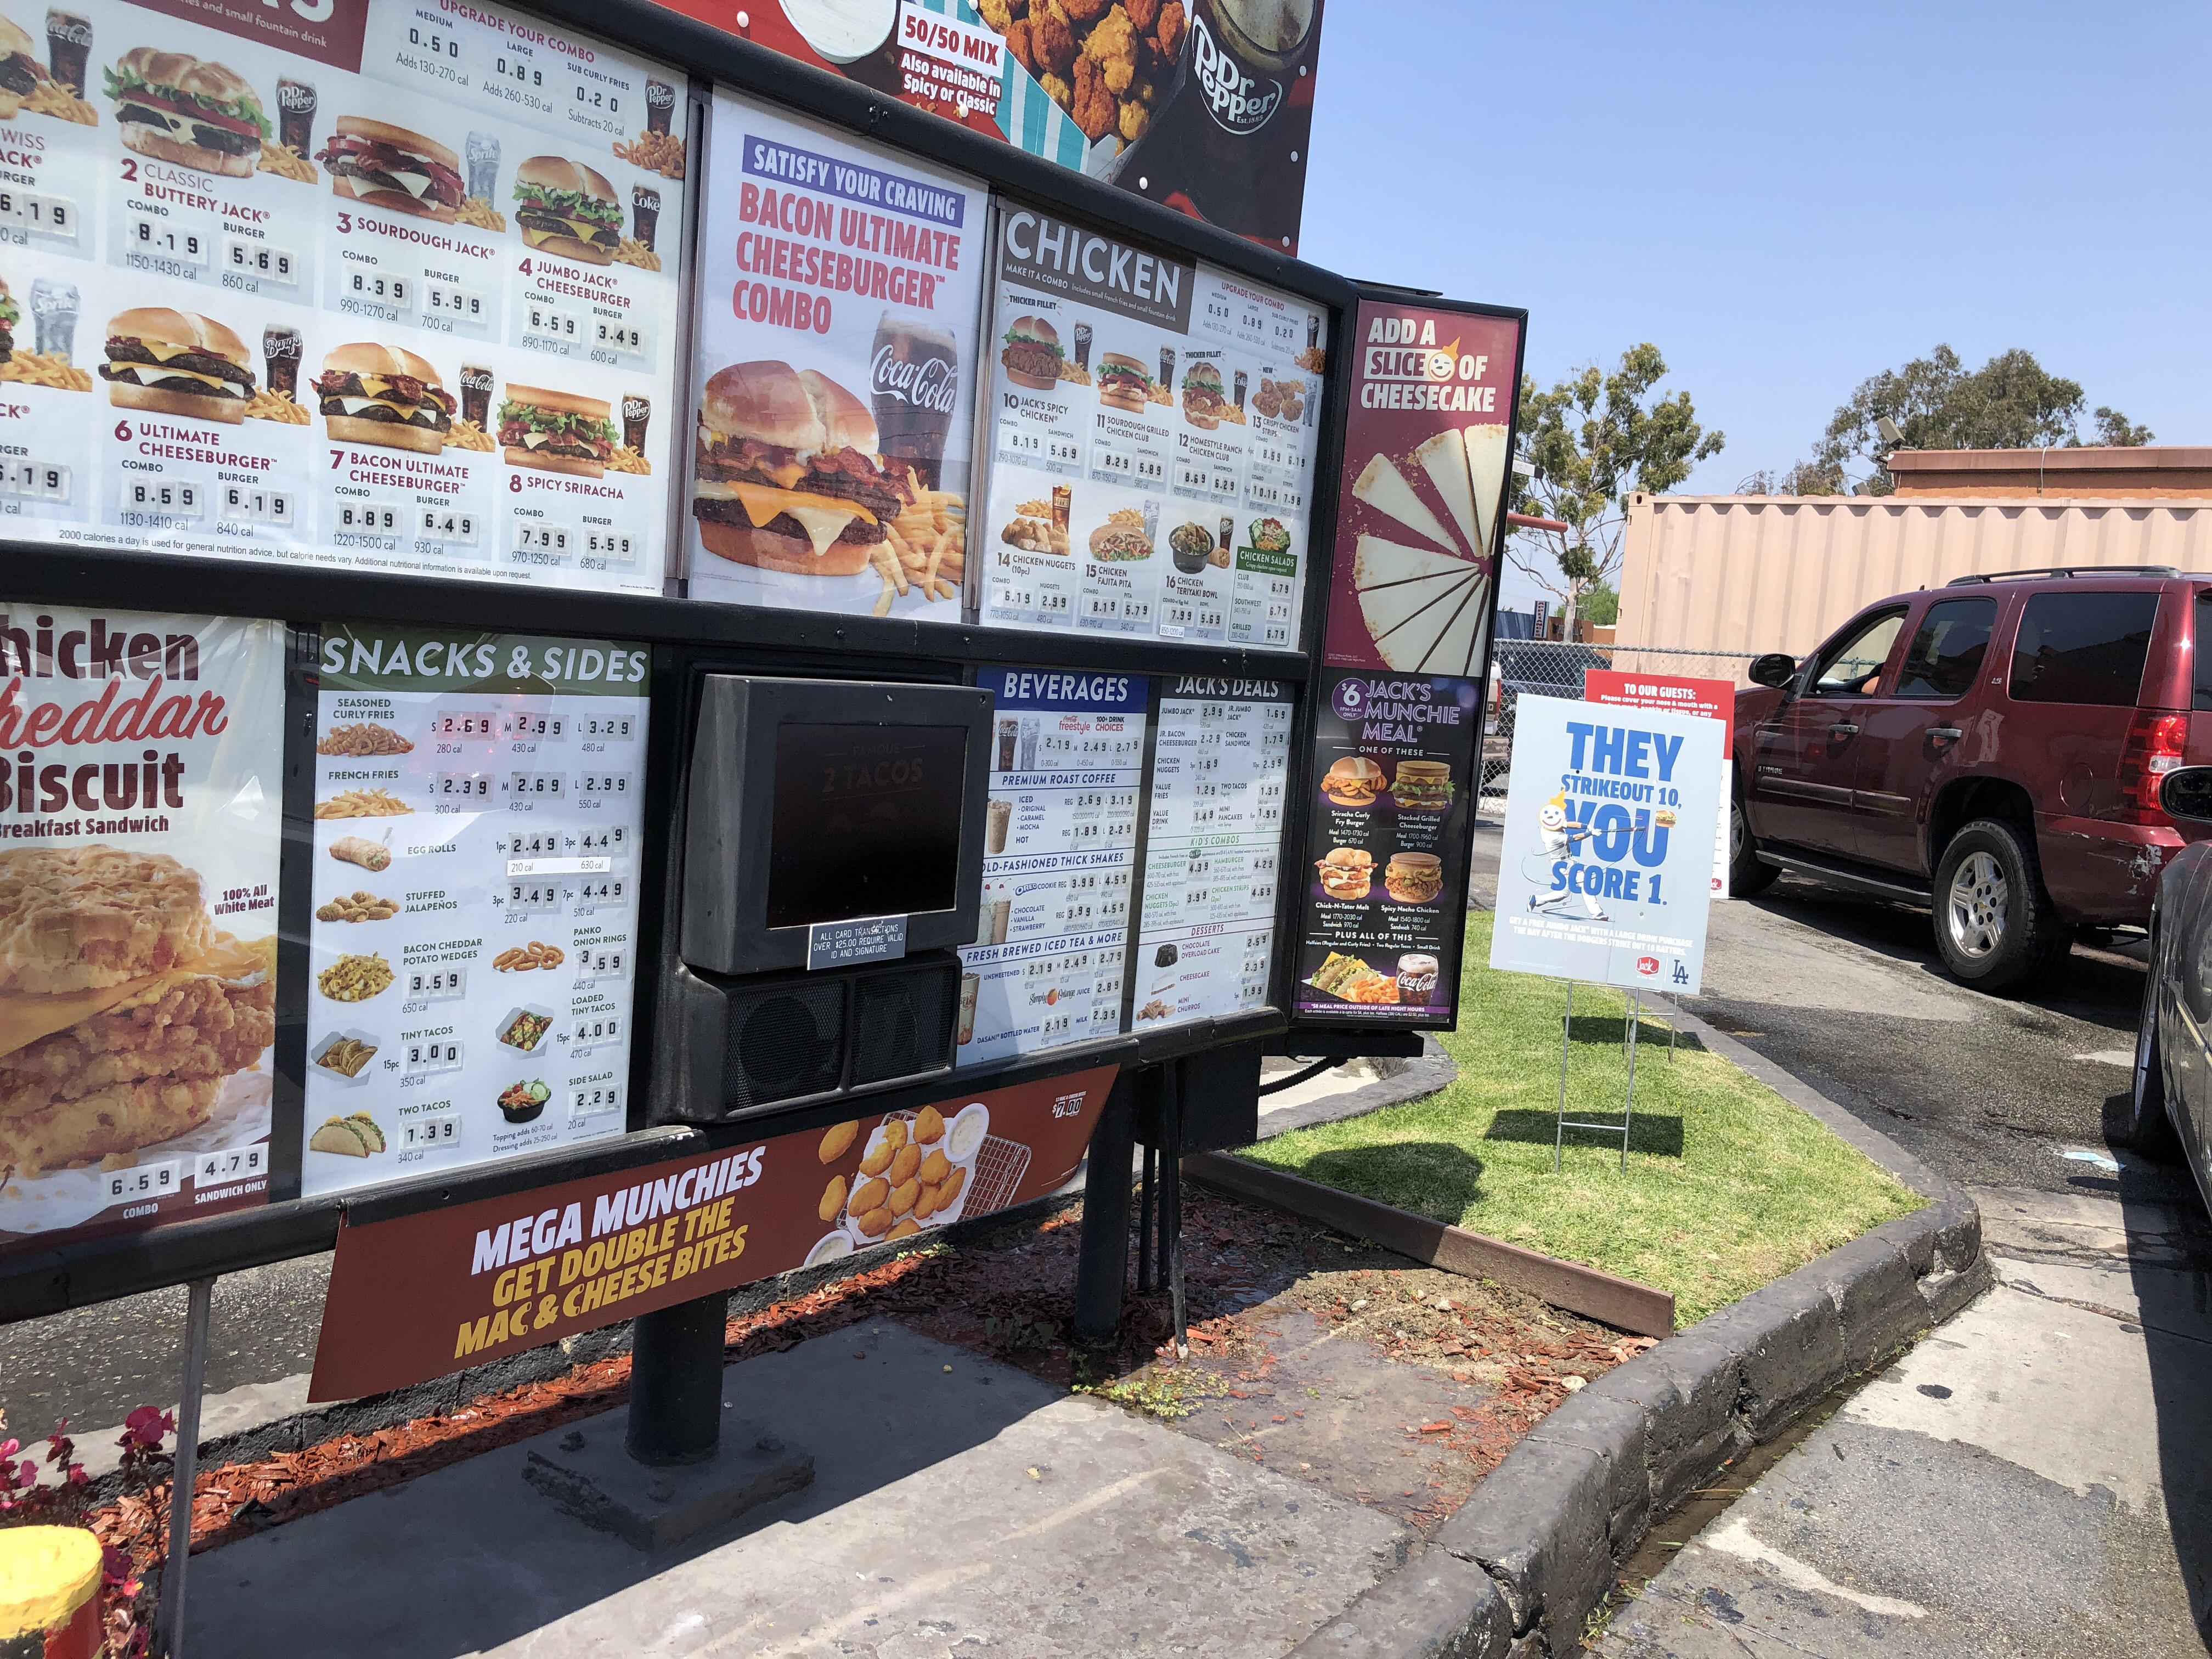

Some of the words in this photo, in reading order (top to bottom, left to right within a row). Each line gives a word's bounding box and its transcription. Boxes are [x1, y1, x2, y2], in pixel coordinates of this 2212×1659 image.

[202, 1, 222, 14] and
[225, 8, 253, 23] small
[255, 14, 298, 38] fountain
[301, 30, 327, 47] drink
[415, 9, 453, 29] MEDIUM
[440, 0, 505, 32] UPGRADE
[508, 22, 545, 45] YOUR
[548, 37, 595, 63] COMBO
[905, 19, 960, 54] 50/50
[963, 38, 999, 67] MIX
[507, 41, 533, 57] LARGE
[901, 54, 930, 75] Also
[932, 63, 986, 93] available
[988, 82, 1001, 98] in
[904, 74, 938, 98] Spicy
[940, 89, 954, 101] or
[956, 91, 996, 116] Classic
[120, 159, 138, 182] 2
[145, 163, 213, 193] CLASSIC
[754, 144, 830, 187] SATISFY
[835, 168, 881, 201] YOUR
[885, 181, 956, 221] CRAVING
[127, 200, 169, 217] COMBO
[144, 184, 217, 212] BUTTERY
[223, 222, 265, 239] BURGER
[336, 212, 352, 233] 3
[357, 218, 452, 250] SOURDOUGH
[740, 182, 834, 241] BACON
[839, 207, 961, 270] ULTIMATE
[1006, 212, 1181, 309] CHICKEN
[1006, 263, 1026, 276] MAKE
[1028, 270, 1035, 278] IT
[1035, 273, 1041, 281] A
[1042, 275, 1068, 289] COMBO
[733, 280, 831, 334] COMBO
[1368, 317, 1415, 344] ADD
[1419, 319, 1436, 346] A
[1370, 351, 1425, 377] SLICE
[1459, 356, 1488, 381] OF
[1047, 402, 1069, 415] SPICY
[1361, 383, 1496, 413] CHEESECAKE
[114, 420, 132, 442] 6
[140, 423, 220, 446] ULTIMATE
[510, 475, 522, 492] 8
[527, 477, 562, 492] SPICY
[565, 481, 624, 499] SRIRACHA
[1012, 566, 1030, 577] (10pc)
[1013, 555, 1043, 566] CHICKEN
[1045, 558, 1075, 571] NUGGETS
[320, 637, 496, 678] SNACKS
[506, 646, 532, 679] &
[541, 647, 647, 682] SIDES
[1003, 673, 1128, 702] BEVERAGES
[1232, 680, 1279, 697] DEALS
[1624, 683, 1636, 695] TO
[1638, 685, 1657, 696] OUR
[1660, 686, 1696, 699] GUESTS:
[337, 698, 391, 708] SEASONED
[1364, 701, 1460, 724] MUNCHIE
[333, 710, 365, 720] CURLY
[367, 710, 394, 719] FRIES
[1095, 724, 1124, 732] CHOICES
[1396, 748, 1423, 756] THESE
[1566, 721, 1684, 782] THEY
[328, 771, 369, 781] FRENCH
[371, 770, 399, 780] FRIES
[1002, 774, 1047, 786] PREMIUM
[1050, 775, 1079, 784] ROAST
[1082, 774, 1116, 783] COFFEE
[1561, 774, 1655, 806] STRIKEOUT
[1659, 788, 1682, 809] 10,
[86, 815, 169, 835] Sandwich
[1564, 799, 1670, 867] YOU
[408, 845, 426, 855] EGG
[428, 844, 456, 854] ROLLS
[1211, 835, 1239, 845] COMBOS
[222, 888, 250, 902] 100%
[252, 884, 268, 898] All
[1550, 861, 1640, 902] SCORE
[1648, 874, 1668, 905] 1.
[214, 899, 246, 915] White
[248, 895, 275, 911] Meat
[405, 890, 445, 901] STUFFED
[405, 899, 458, 913] JALAPEÑOS
[821, 933, 832, 941] ALL
[836, 930, 851, 939] CARD
[1191, 924, 1224, 936] DESSERTS
[814, 942, 830, 951] OVER
[836, 939, 856, 949] $25.00
[859, 935, 884, 945] REQUIRE
[887, 933, 903, 941] VALID
[831, 951, 837, 959] ID
[840, 949, 852, 957] AND
[855, 944, 888, 956] SIGNATURE
[966, 949, 998, 962] FRESH
[1002, 943, 1041, 957] BREWED
[1044, 939, 1065, 951] ICED
[1069, 937, 1086, 947] TEA
[1088, 936, 1094, 945] &
[1097, 933, 1122, 944] MORE
[1180, 970, 1210, 981] CHEESECAKE
[1672, 959, 1689, 985] LA
[569, 1075, 586, 1086] SIDE
[588, 1071, 613, 1084] SALAD
[398, 1105, 419, 1116] TWO
[421, 1100, 452, 1113] TACOS
[194, 1184, 244, 1205] SANDWICH
[242, 1180, 268, 1195] ONLY
[122, 1203, 159, 1219] COMBO
[471, 1204, 583, 1276] MEGA
[589, 1146, 767, 1238] MUNCHIES
[492, 1257, 557, 1307] GET
[558, 1214, 683, 1288] DOUBLE
[684, 1196, 736, 1246] THE
[454, 1298, 530, 1359] MAC
[532, 1290, 558, 1333] &
[561, 1249, 669, 1318] CHEESE
[671, 1225, 749, 1276] BITES
